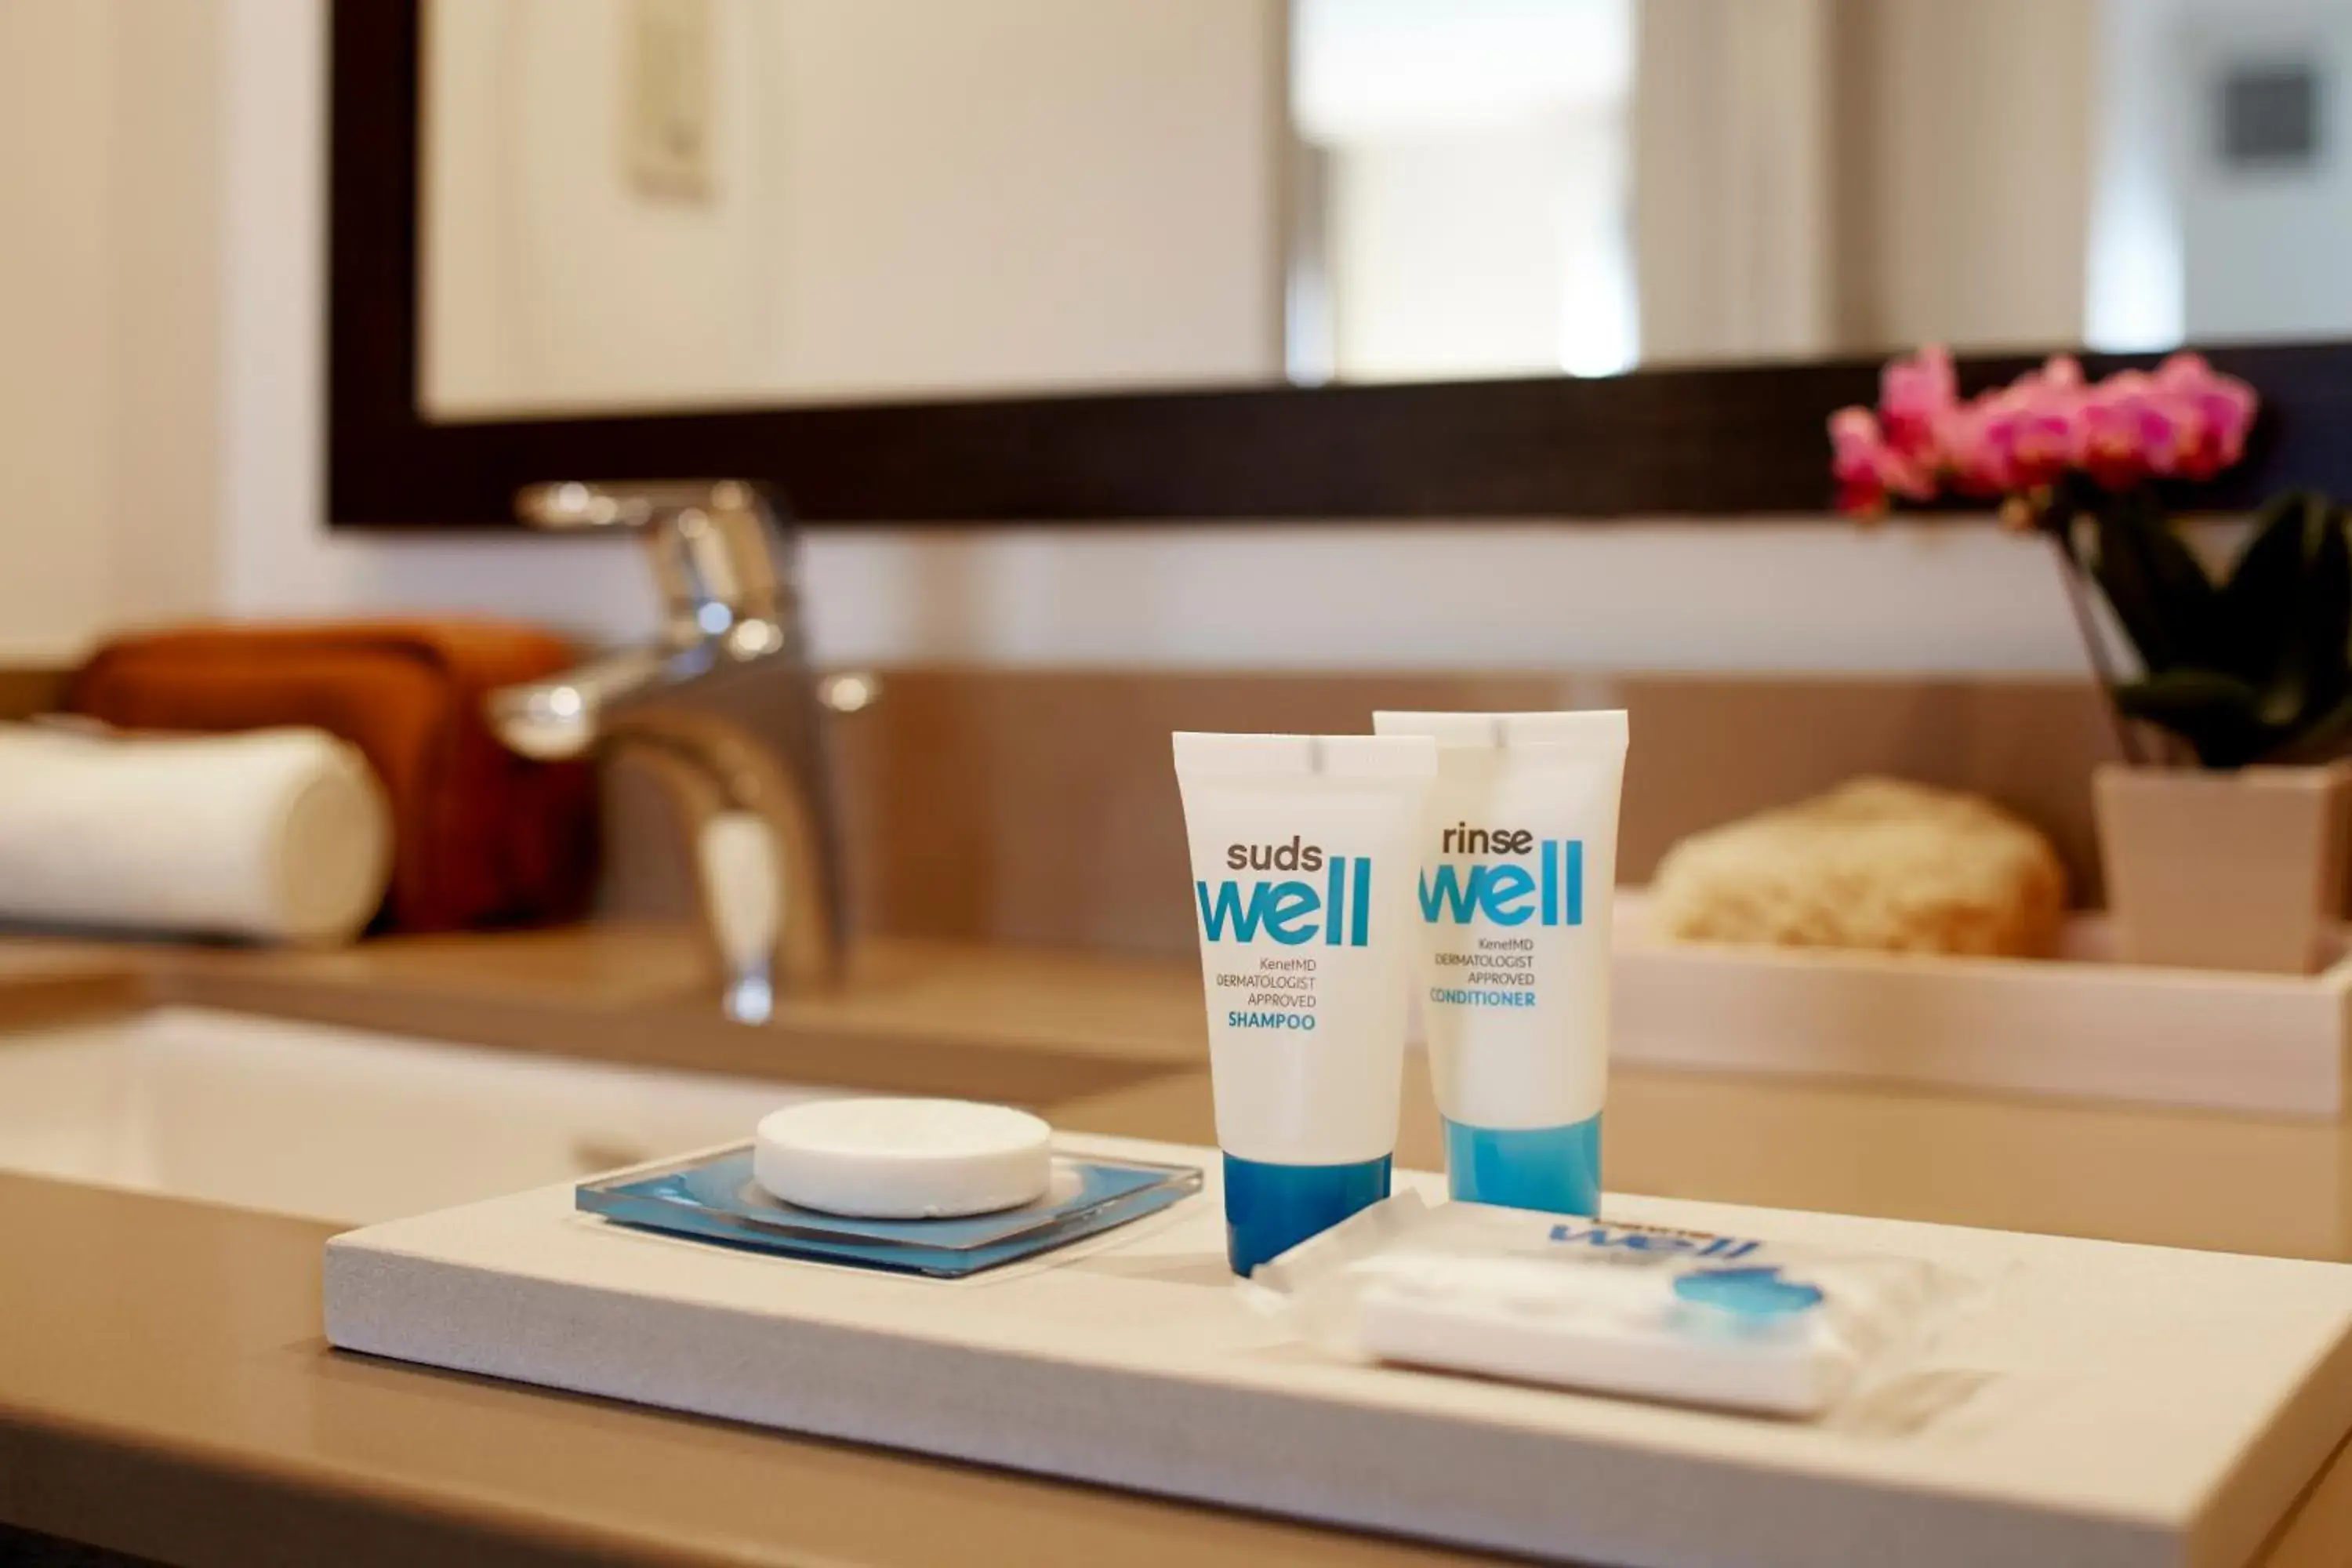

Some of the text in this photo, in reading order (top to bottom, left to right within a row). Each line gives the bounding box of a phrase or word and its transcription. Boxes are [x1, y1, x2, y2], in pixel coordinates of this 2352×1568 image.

[1443, 821, 1534, 855] rinse
[1226, 835, 1323, 872] suds
[1418, 840, 1583, 927] well
[1196, 855, 1371, 947] well
[1435, 953, 1534, 969] DERMATOLOGIST
[1216, 973, 1316, 991] DERMATOLOGIST
[1468, 971, 1535, 986] APPROVED
[1247, 992, 1317, 1008] APPROVED
[1430, 987, 1537, 1007] CONDITIONER
[1229, 1011, 1316, 1031] SHAMPOO
